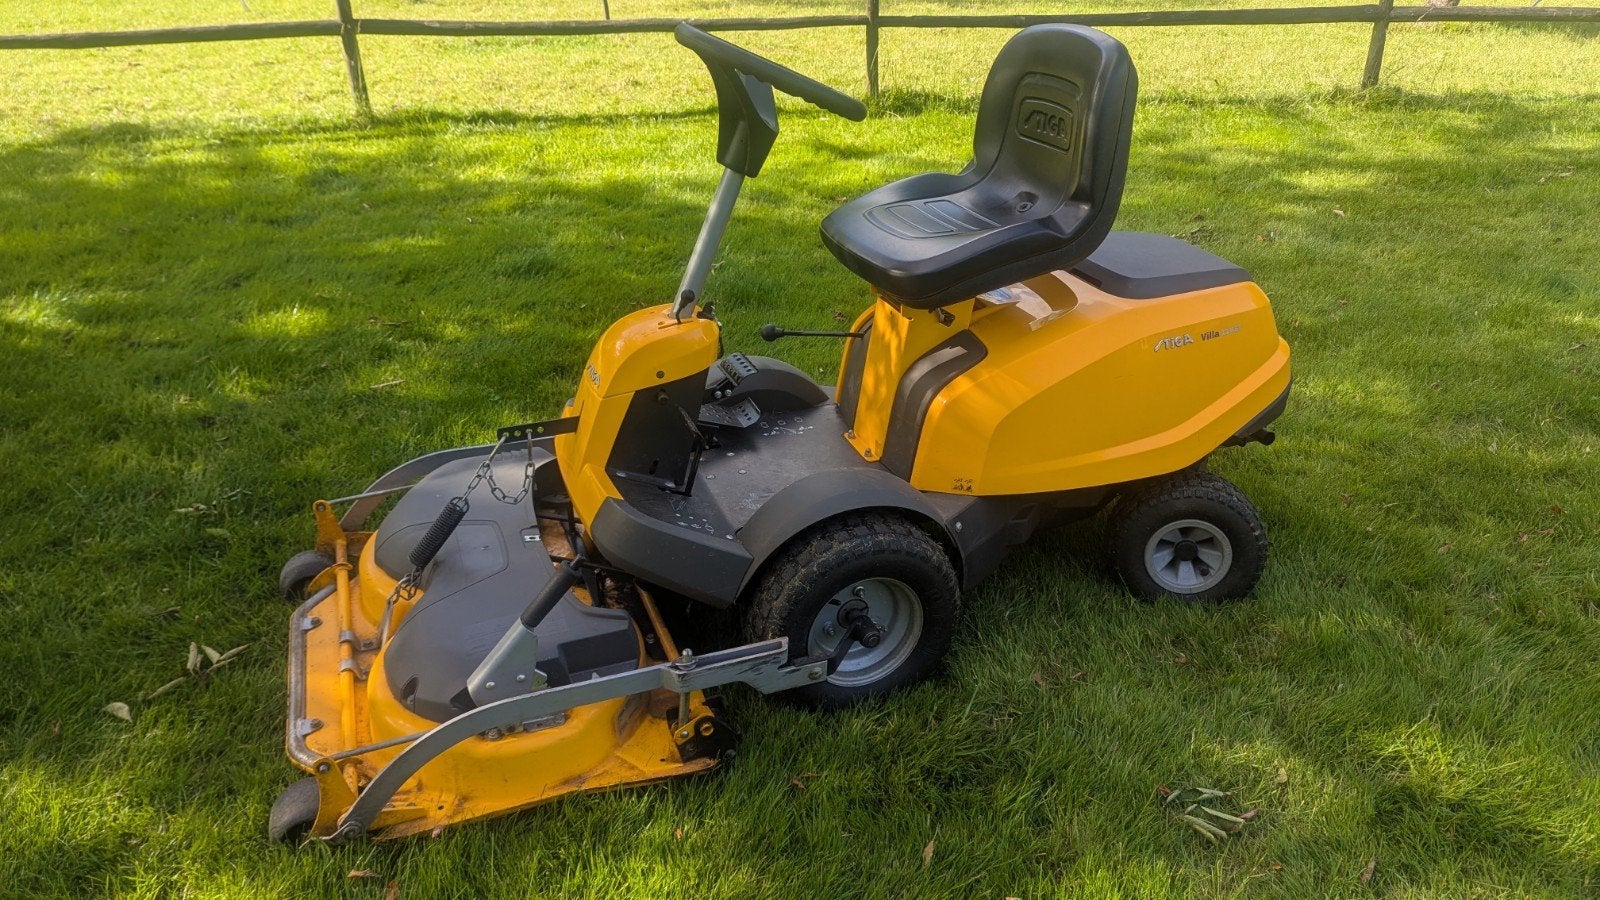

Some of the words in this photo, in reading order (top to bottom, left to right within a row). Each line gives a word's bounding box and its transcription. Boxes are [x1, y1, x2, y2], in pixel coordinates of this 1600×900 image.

[1024, 110, 1067, 142] STIGA
[1154, 333, 1194, 352] STIGA
[1200, 330, 1220, 342] Villa
